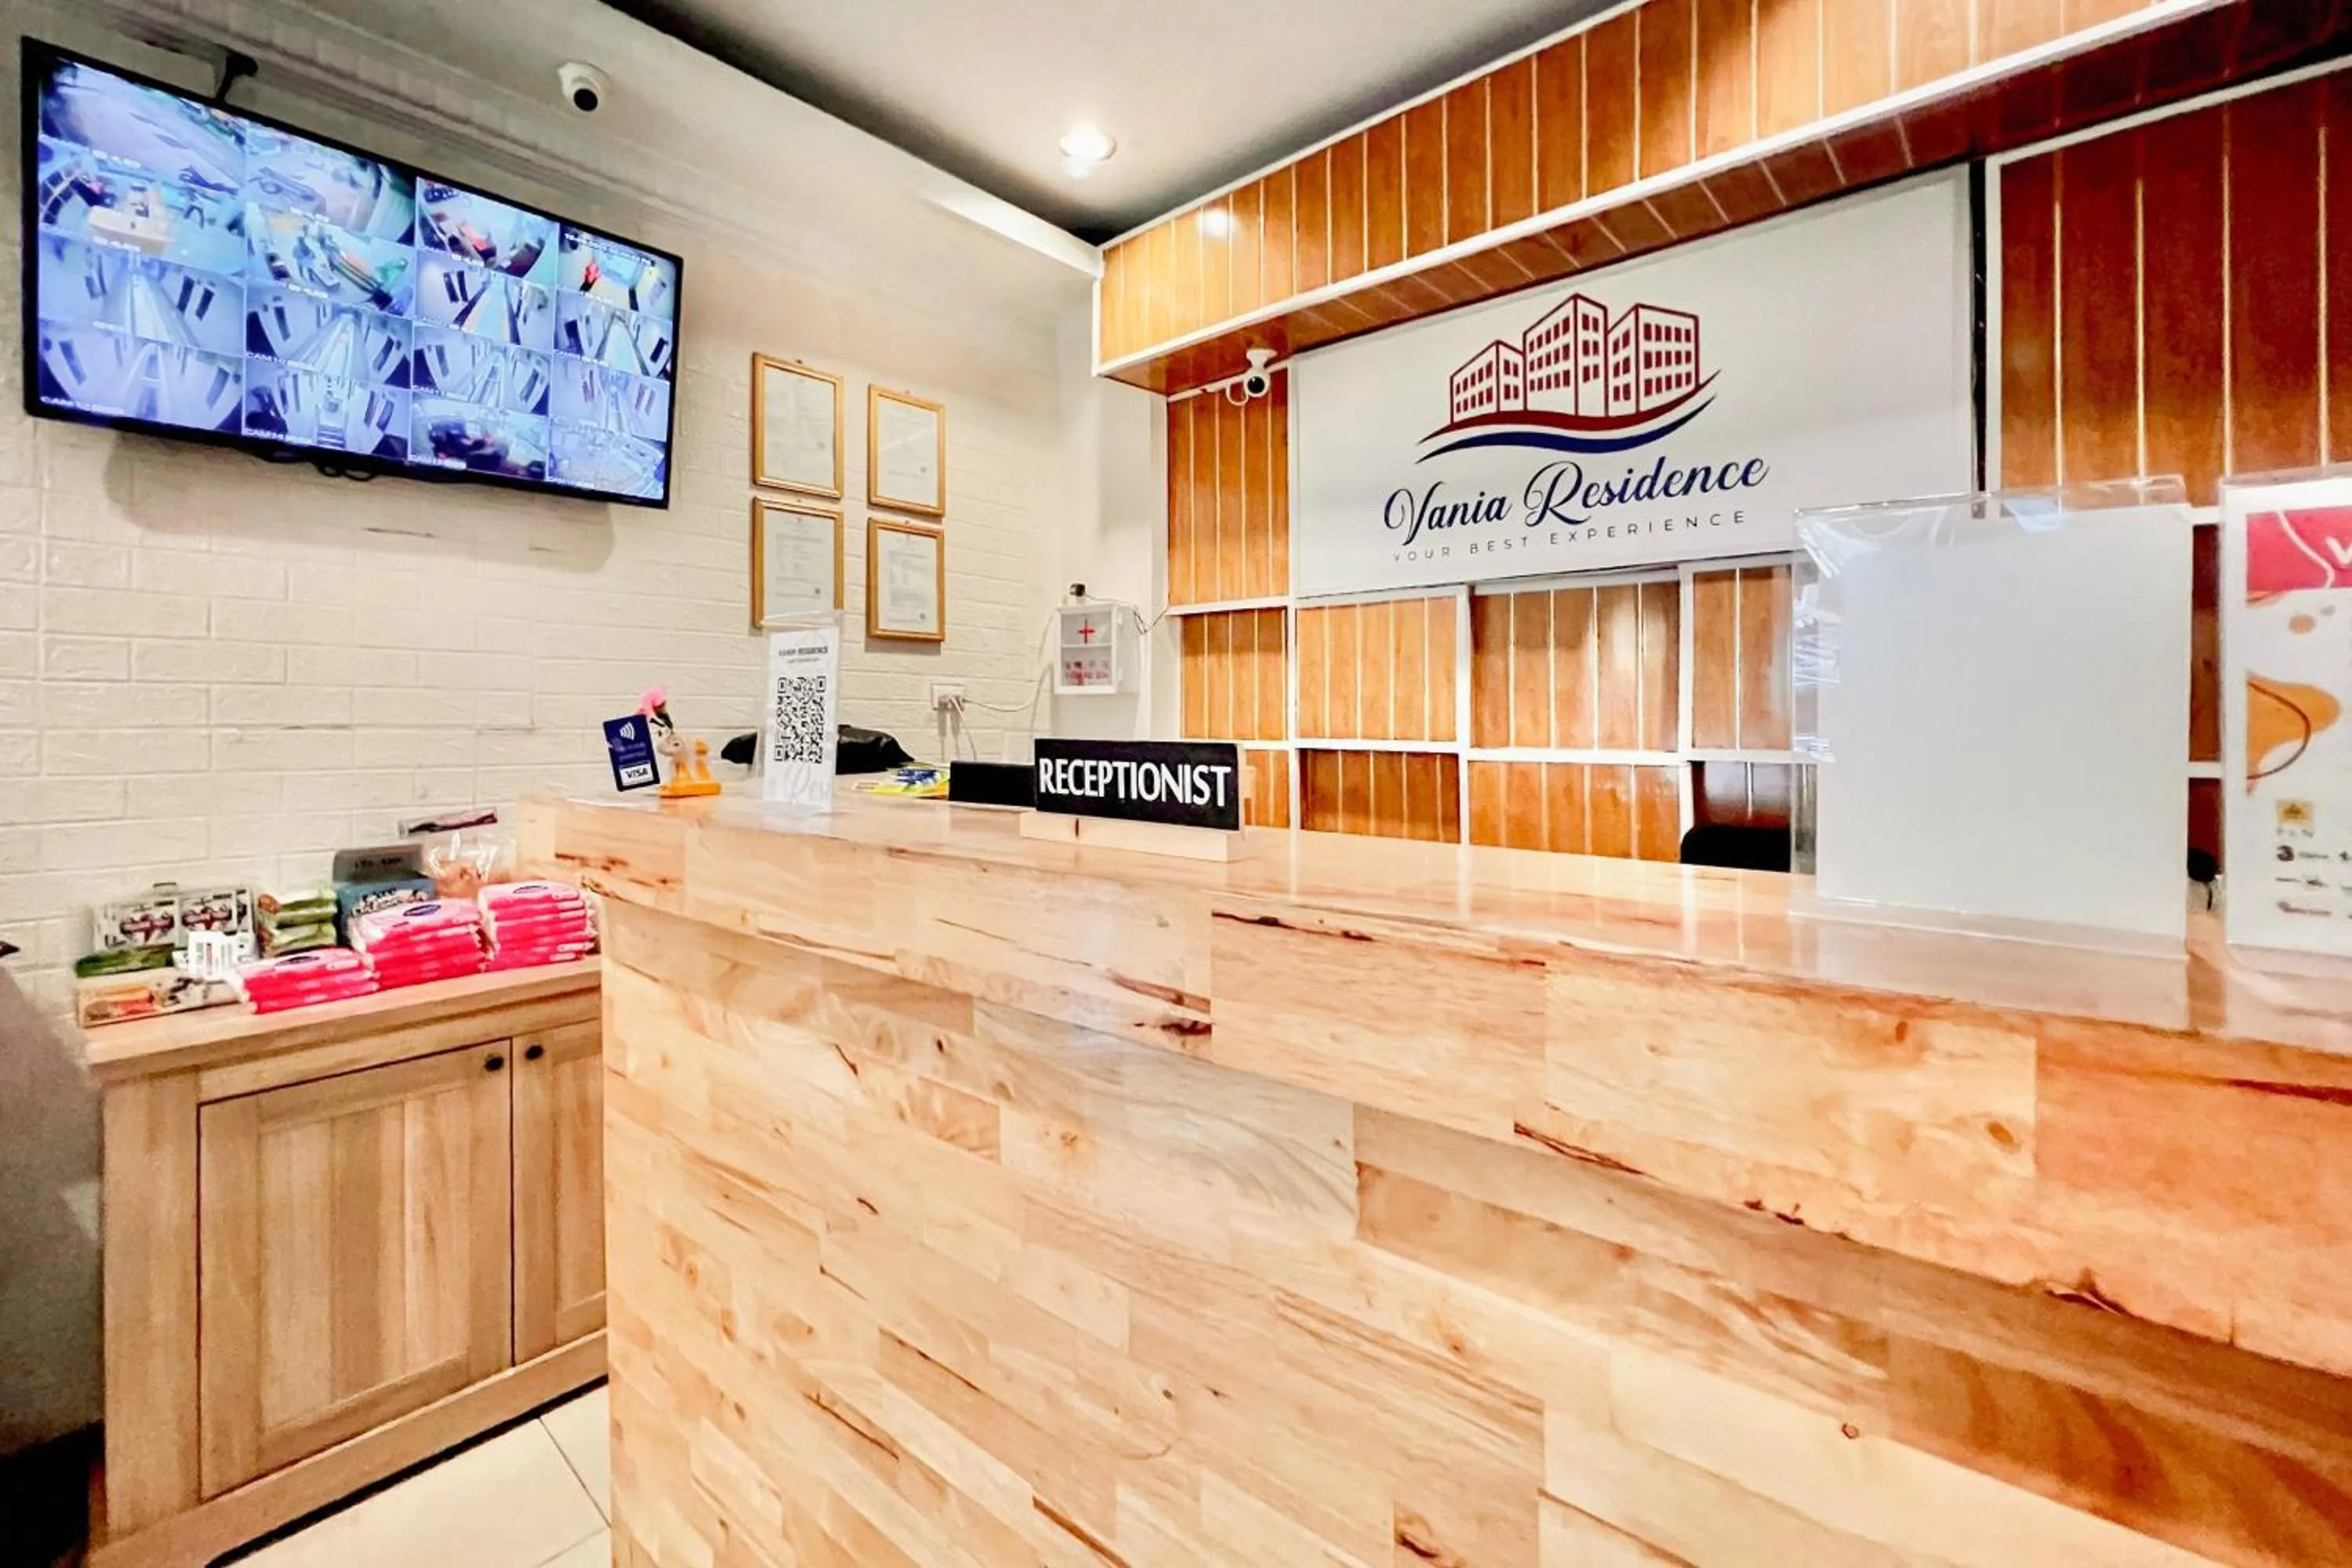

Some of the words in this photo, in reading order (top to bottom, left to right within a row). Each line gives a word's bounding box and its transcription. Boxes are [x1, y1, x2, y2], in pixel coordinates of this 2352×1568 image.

[1384, 481, 1513, 546] Vania
[1523, 455, 1769, 528] Residence
[1392, 546, 1451, 563] YOUR
[1469, 536, 1528, 554] BEST
[1549, 510, 1745, 546] EXPERIENCE
[626, 767, 649, 779] VISA
[1039, 757, 1232, 808] RECEPTIONIST
